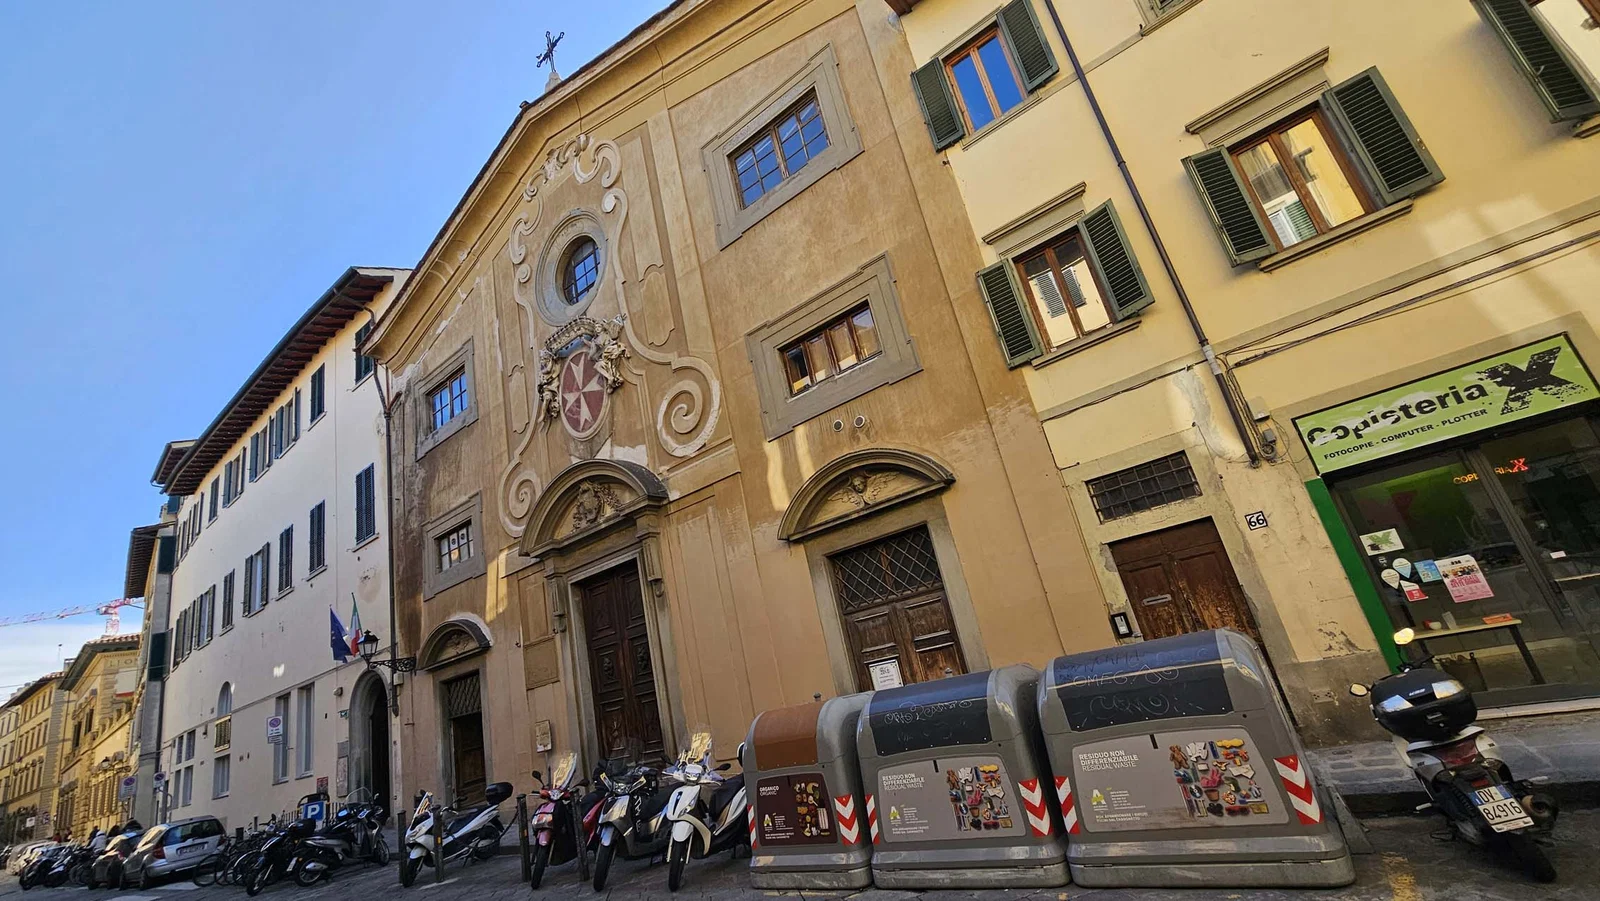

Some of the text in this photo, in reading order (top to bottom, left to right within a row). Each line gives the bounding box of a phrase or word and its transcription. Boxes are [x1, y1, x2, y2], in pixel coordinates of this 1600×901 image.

[1307, 383, 1489, 446] Copisteria
[1323, 440, 1375, 461] FOTOCOPIE
[1381, 423, 1434, 444] COMPUTER
[1440, 407, 1488, 426] PLOTTER
[1248, 514, 1265, 528] 66
[1078, 752, 1109, 760] RESIDUO
[1080, 755, 1139, 766] DIFFERENZIABILE
[1082, 761, 1137, 772] RESIDUAL WASTE
[1477, 788, 1496, 803] DV
[307, 804, 320, 819] P
[1482, 801, 1522, 821] 84916
